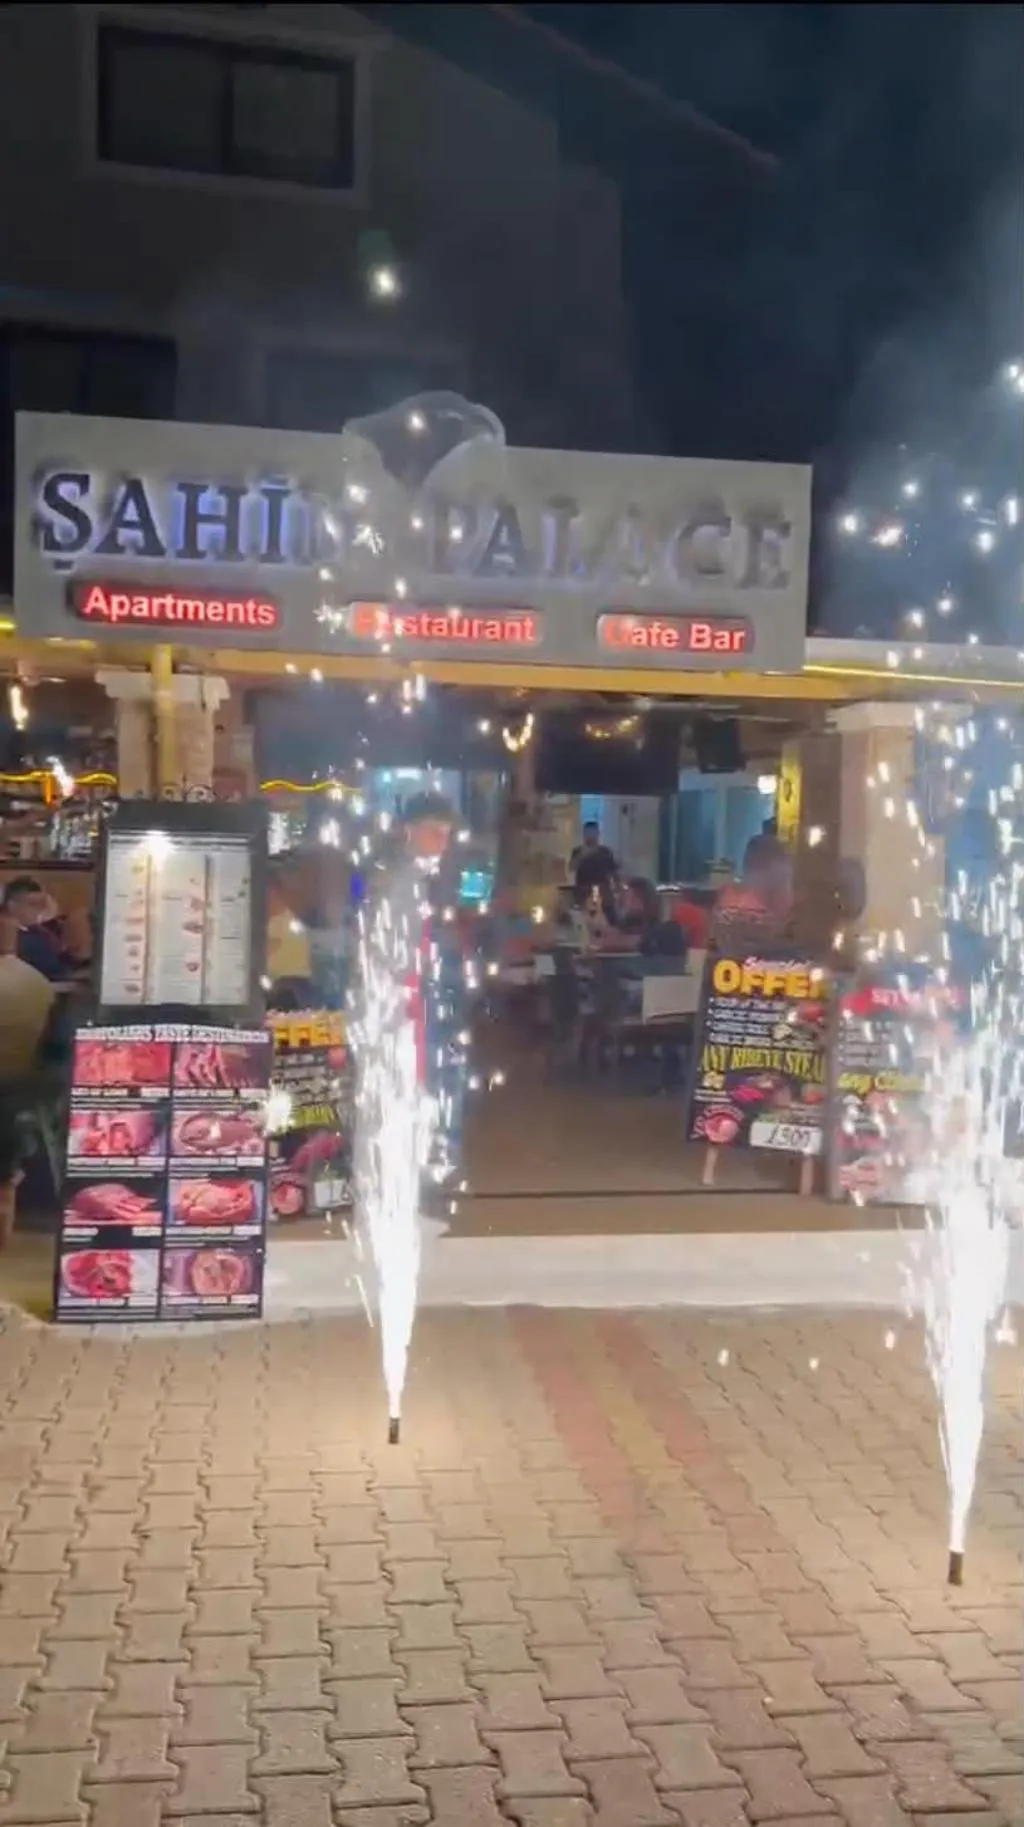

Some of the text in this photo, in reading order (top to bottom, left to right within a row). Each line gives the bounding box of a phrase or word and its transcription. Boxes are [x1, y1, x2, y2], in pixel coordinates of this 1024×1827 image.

[83, 586, 277, 626] Apartments
[604, 618, 746, 651] Cafe Bar
